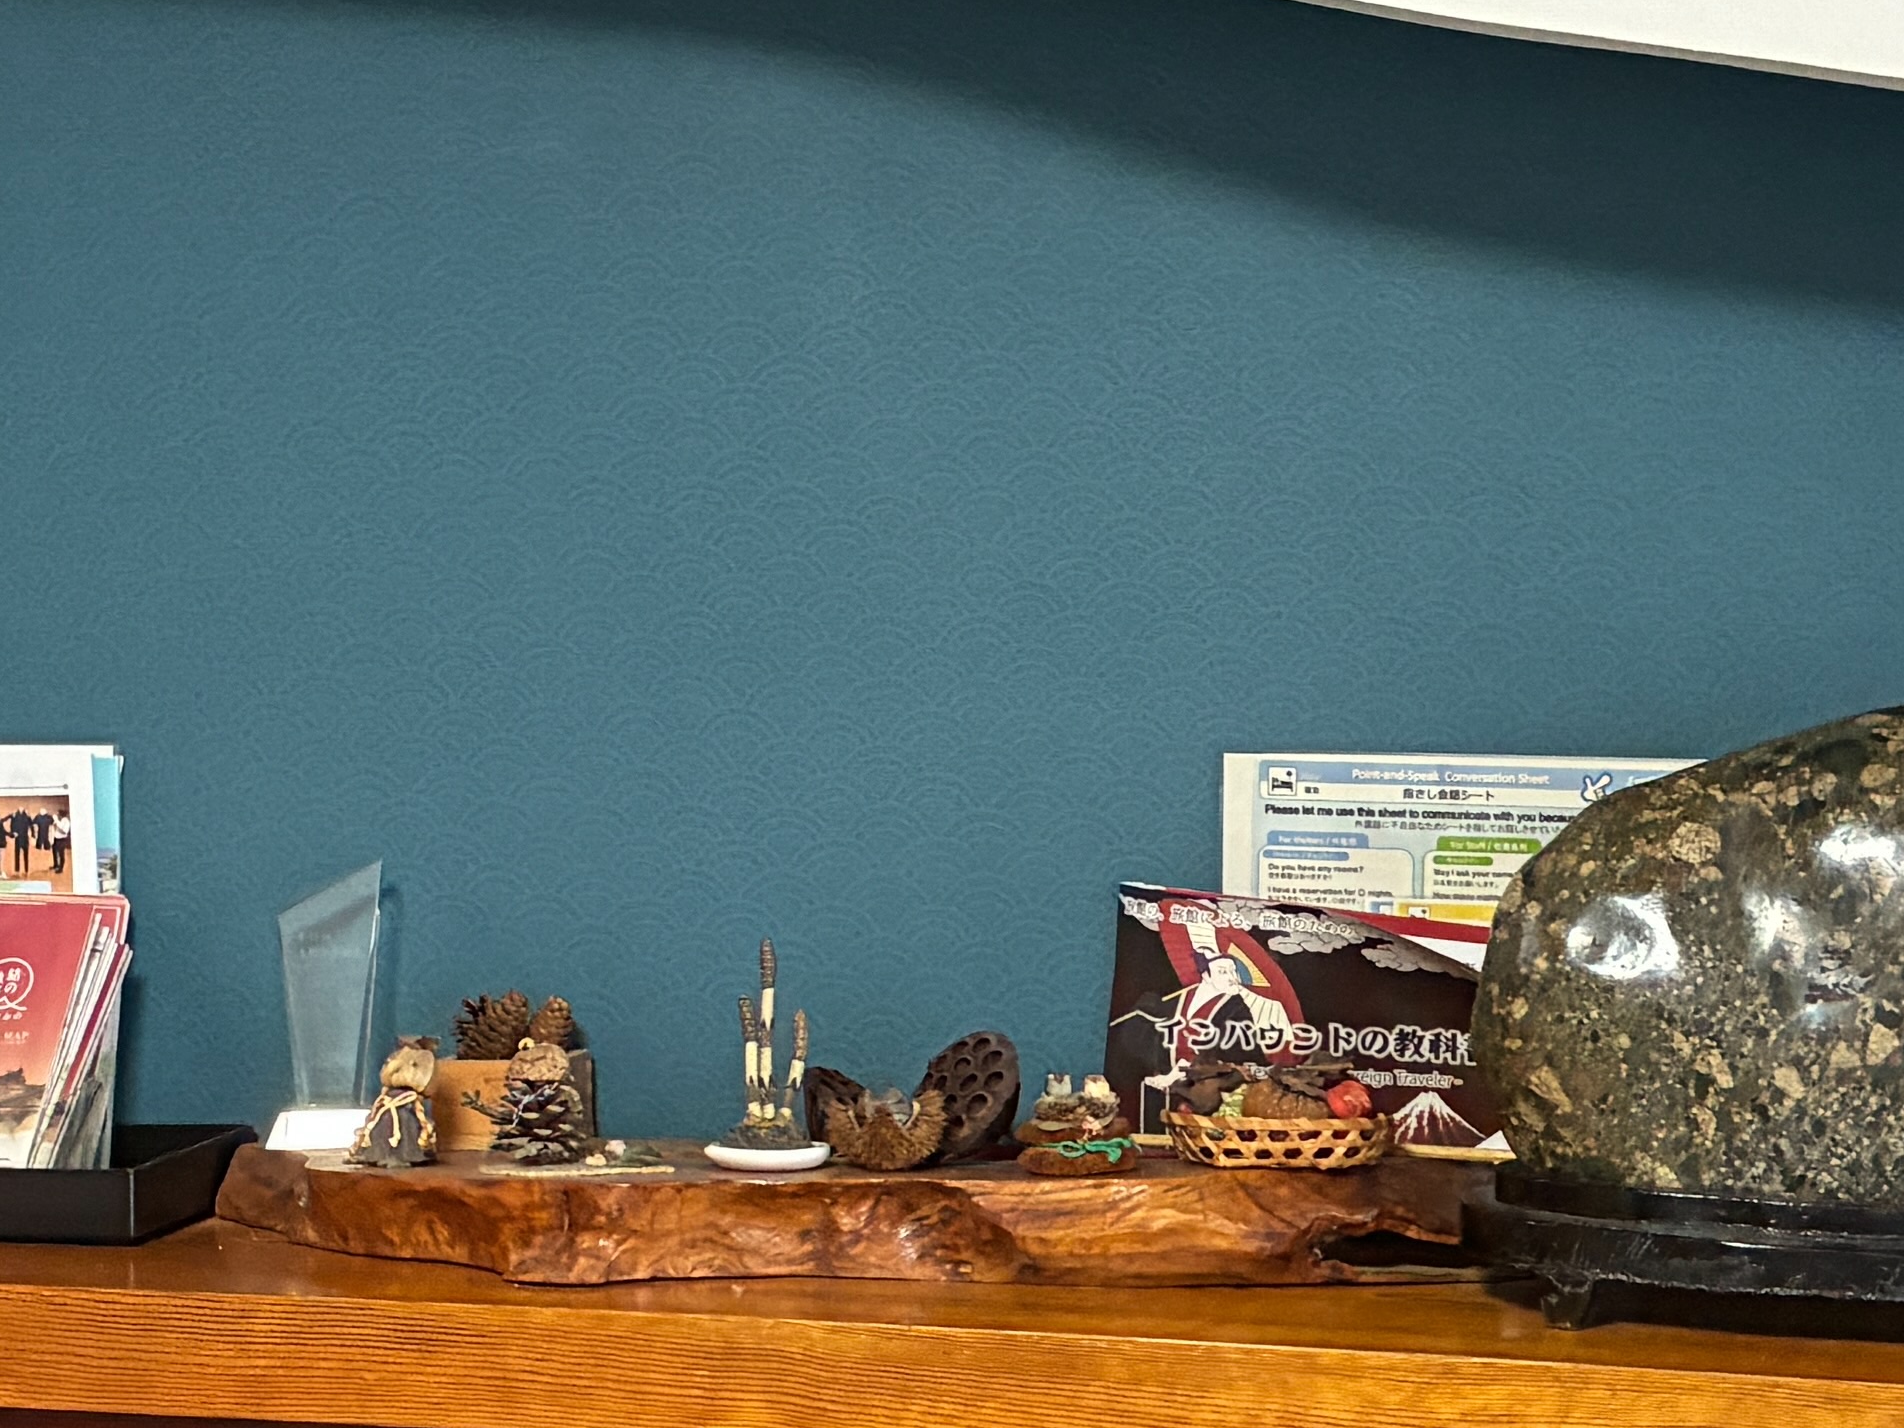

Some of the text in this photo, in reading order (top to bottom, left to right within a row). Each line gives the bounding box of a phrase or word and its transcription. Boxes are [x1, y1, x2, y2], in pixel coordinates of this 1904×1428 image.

[1352, 768, 1550, 785] Point-and-Speak Conversation Sheet
[1264, 803, 1300, 816] Please
[1302, 805, 1315, 816] let
[1317, 807, 1334, 816] me
[1335, 807, 1355, 817] use
[1357, 806, 1376, 818] this
[1378, 808, 1407, 819] sheet
[1408, 810, 1420, 819] to
[1421, 809, 1492, 820] communicate
[1493, 811, 1514, 822] with
[1517, 813, 1537, 824] you
